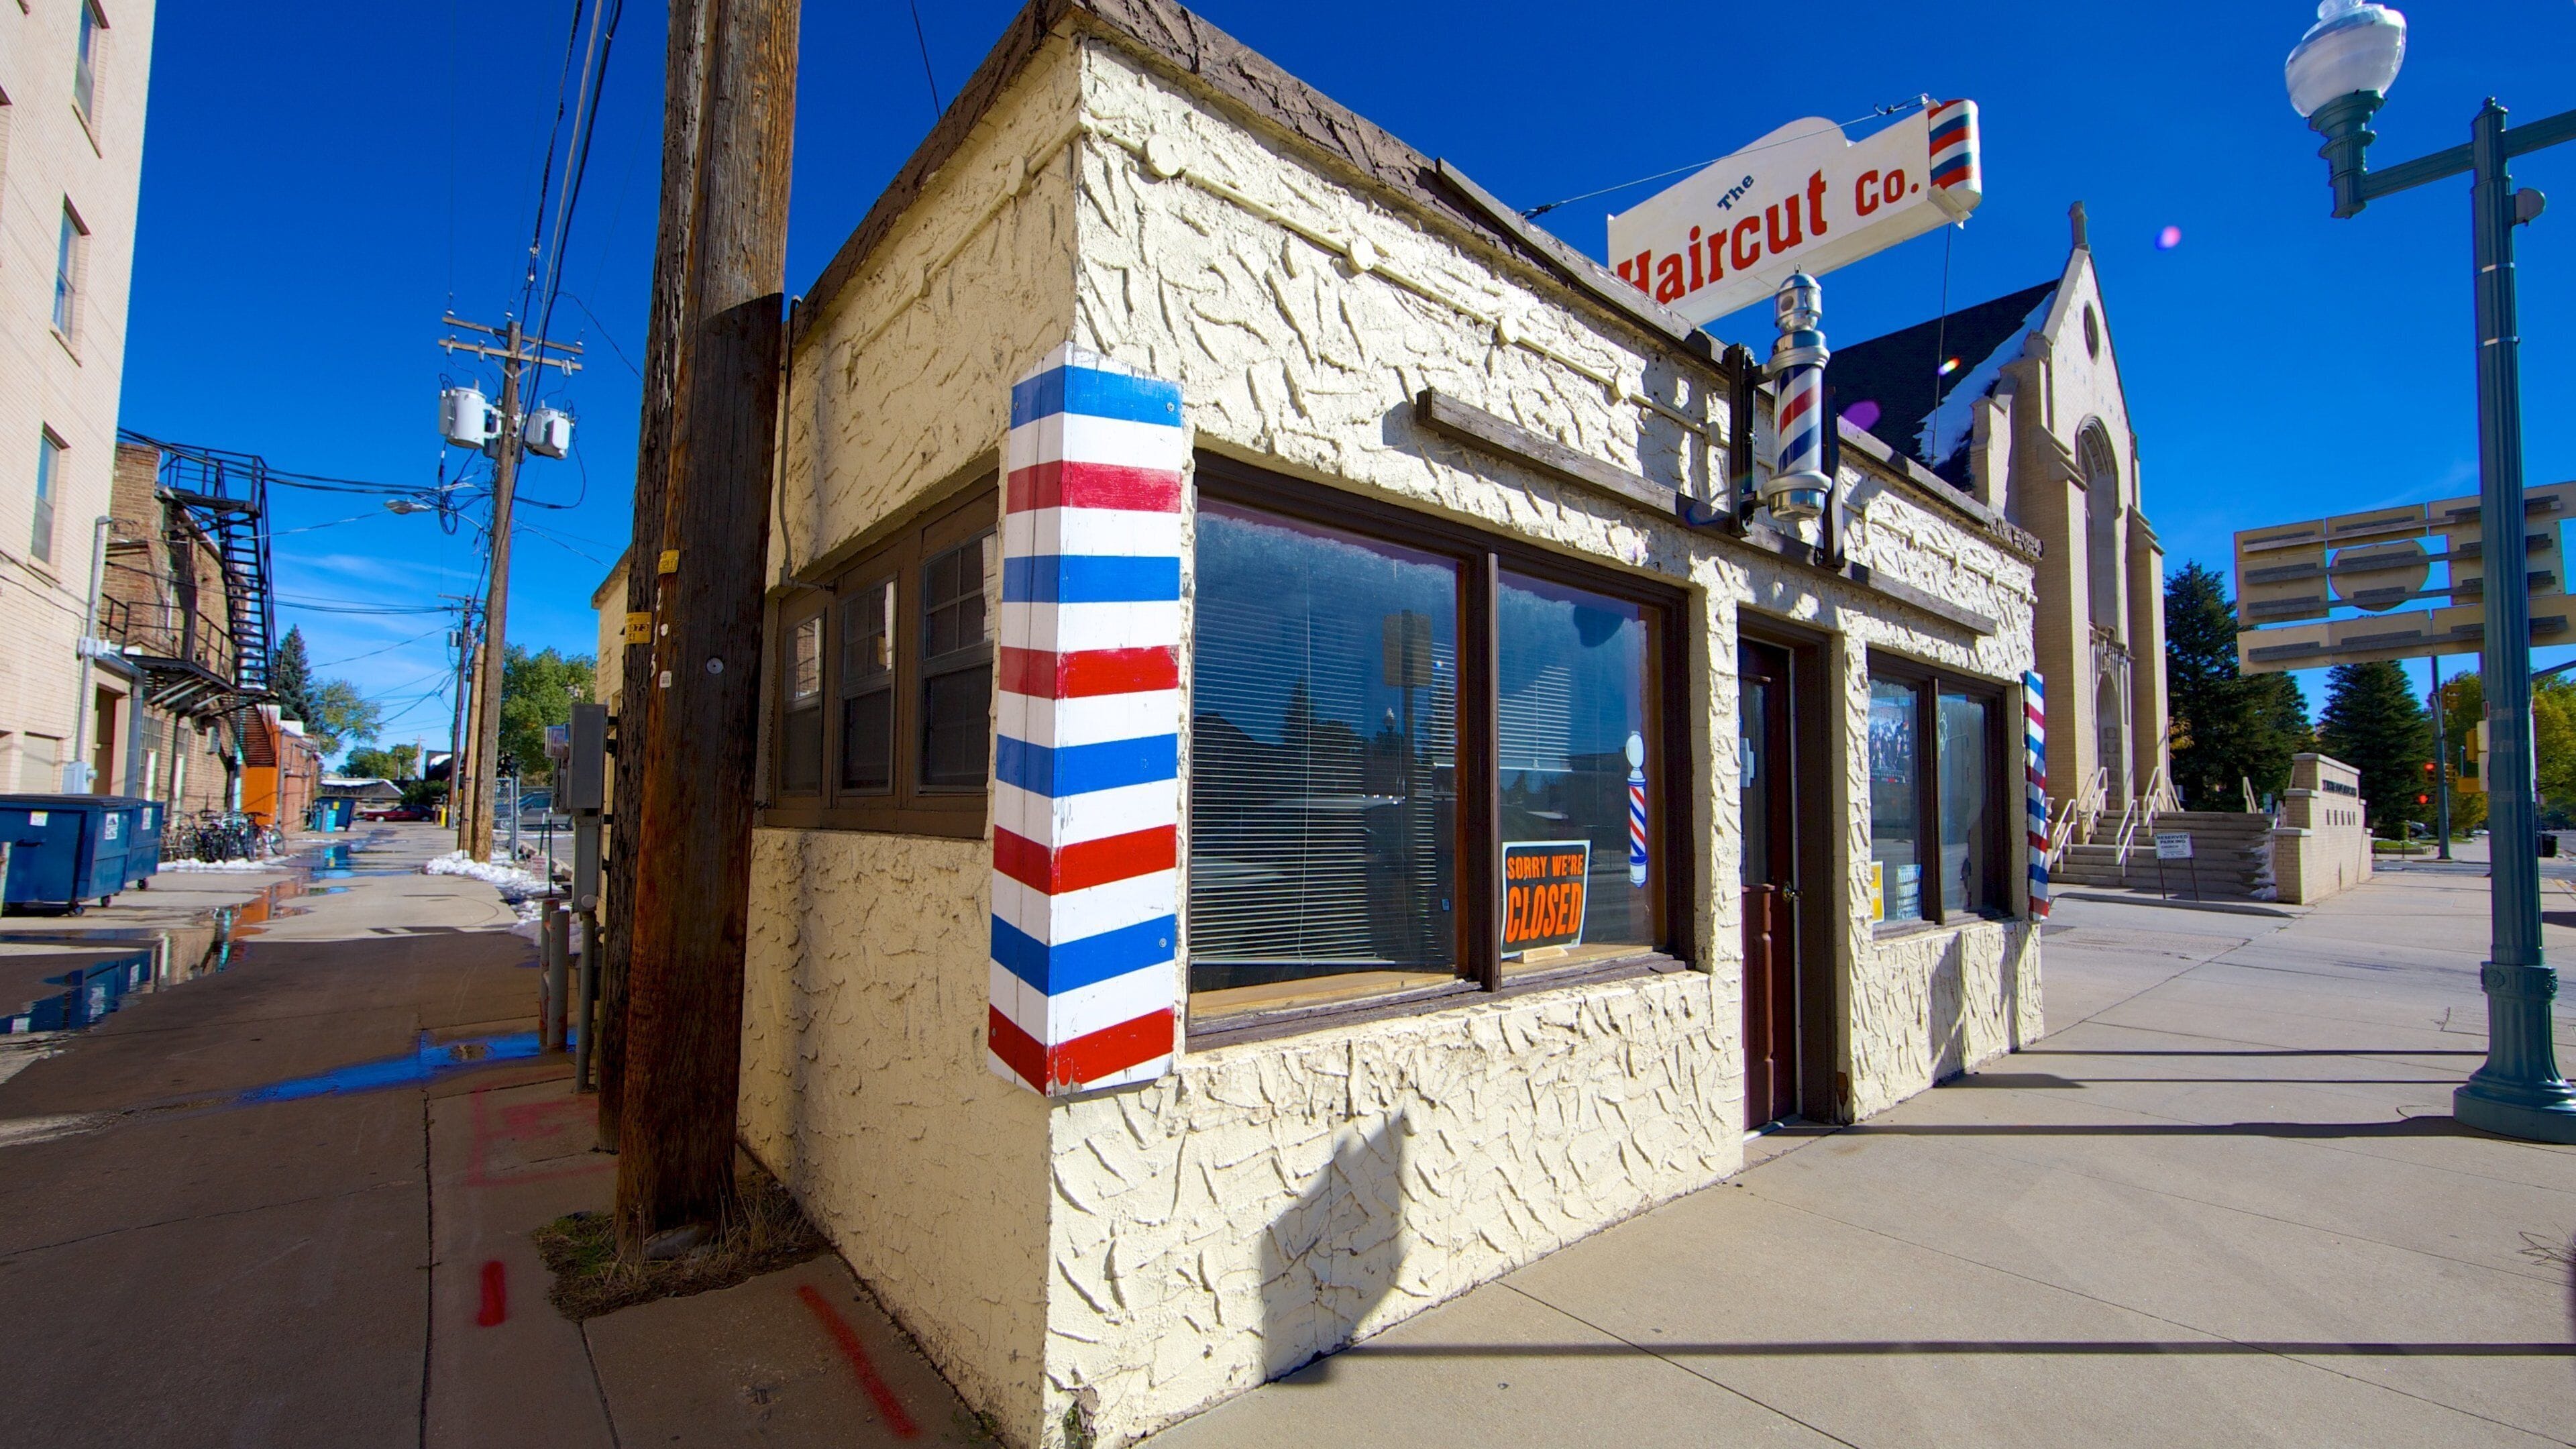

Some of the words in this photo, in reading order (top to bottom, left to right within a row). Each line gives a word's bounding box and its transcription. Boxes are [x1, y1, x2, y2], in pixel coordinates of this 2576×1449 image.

[1717, 175, 1754, 211] The
[1617, 168, 1827, 305] Haircut
[1856, 168, 1919, 217] Co.
[1507, 856, 1547, 879] SORRY
[1552, 855, 1583, 876] WE'RE
[1505, 882, 1582, 943] CLOSED
